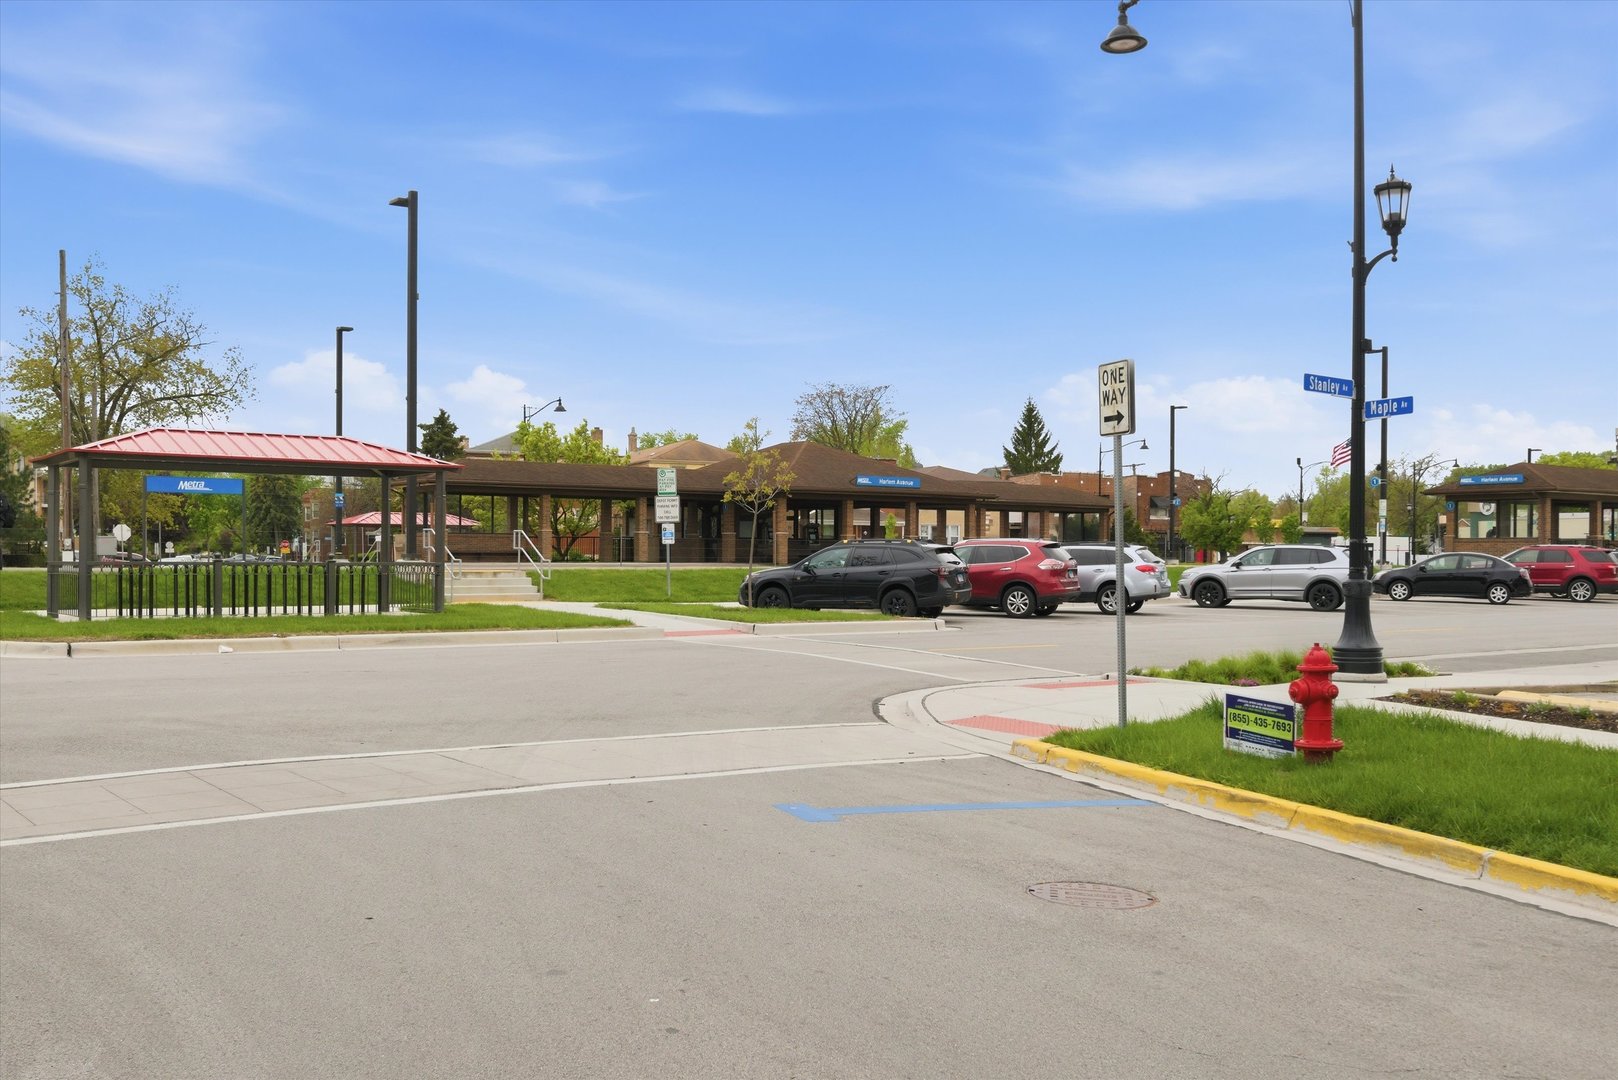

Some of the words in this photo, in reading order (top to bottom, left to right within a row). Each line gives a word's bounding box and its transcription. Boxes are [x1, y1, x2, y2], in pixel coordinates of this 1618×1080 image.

[1102, 366, 1125, 386] ONE
[1309, 376, 1340, 395] Stanley
[1102, 387, 1126, 406] WAY
[1370, 399, 1398, 416] Maple
[177, 480, 205, 491] Metra
[1229, 712, 1292, 733] (855)-435-7693
